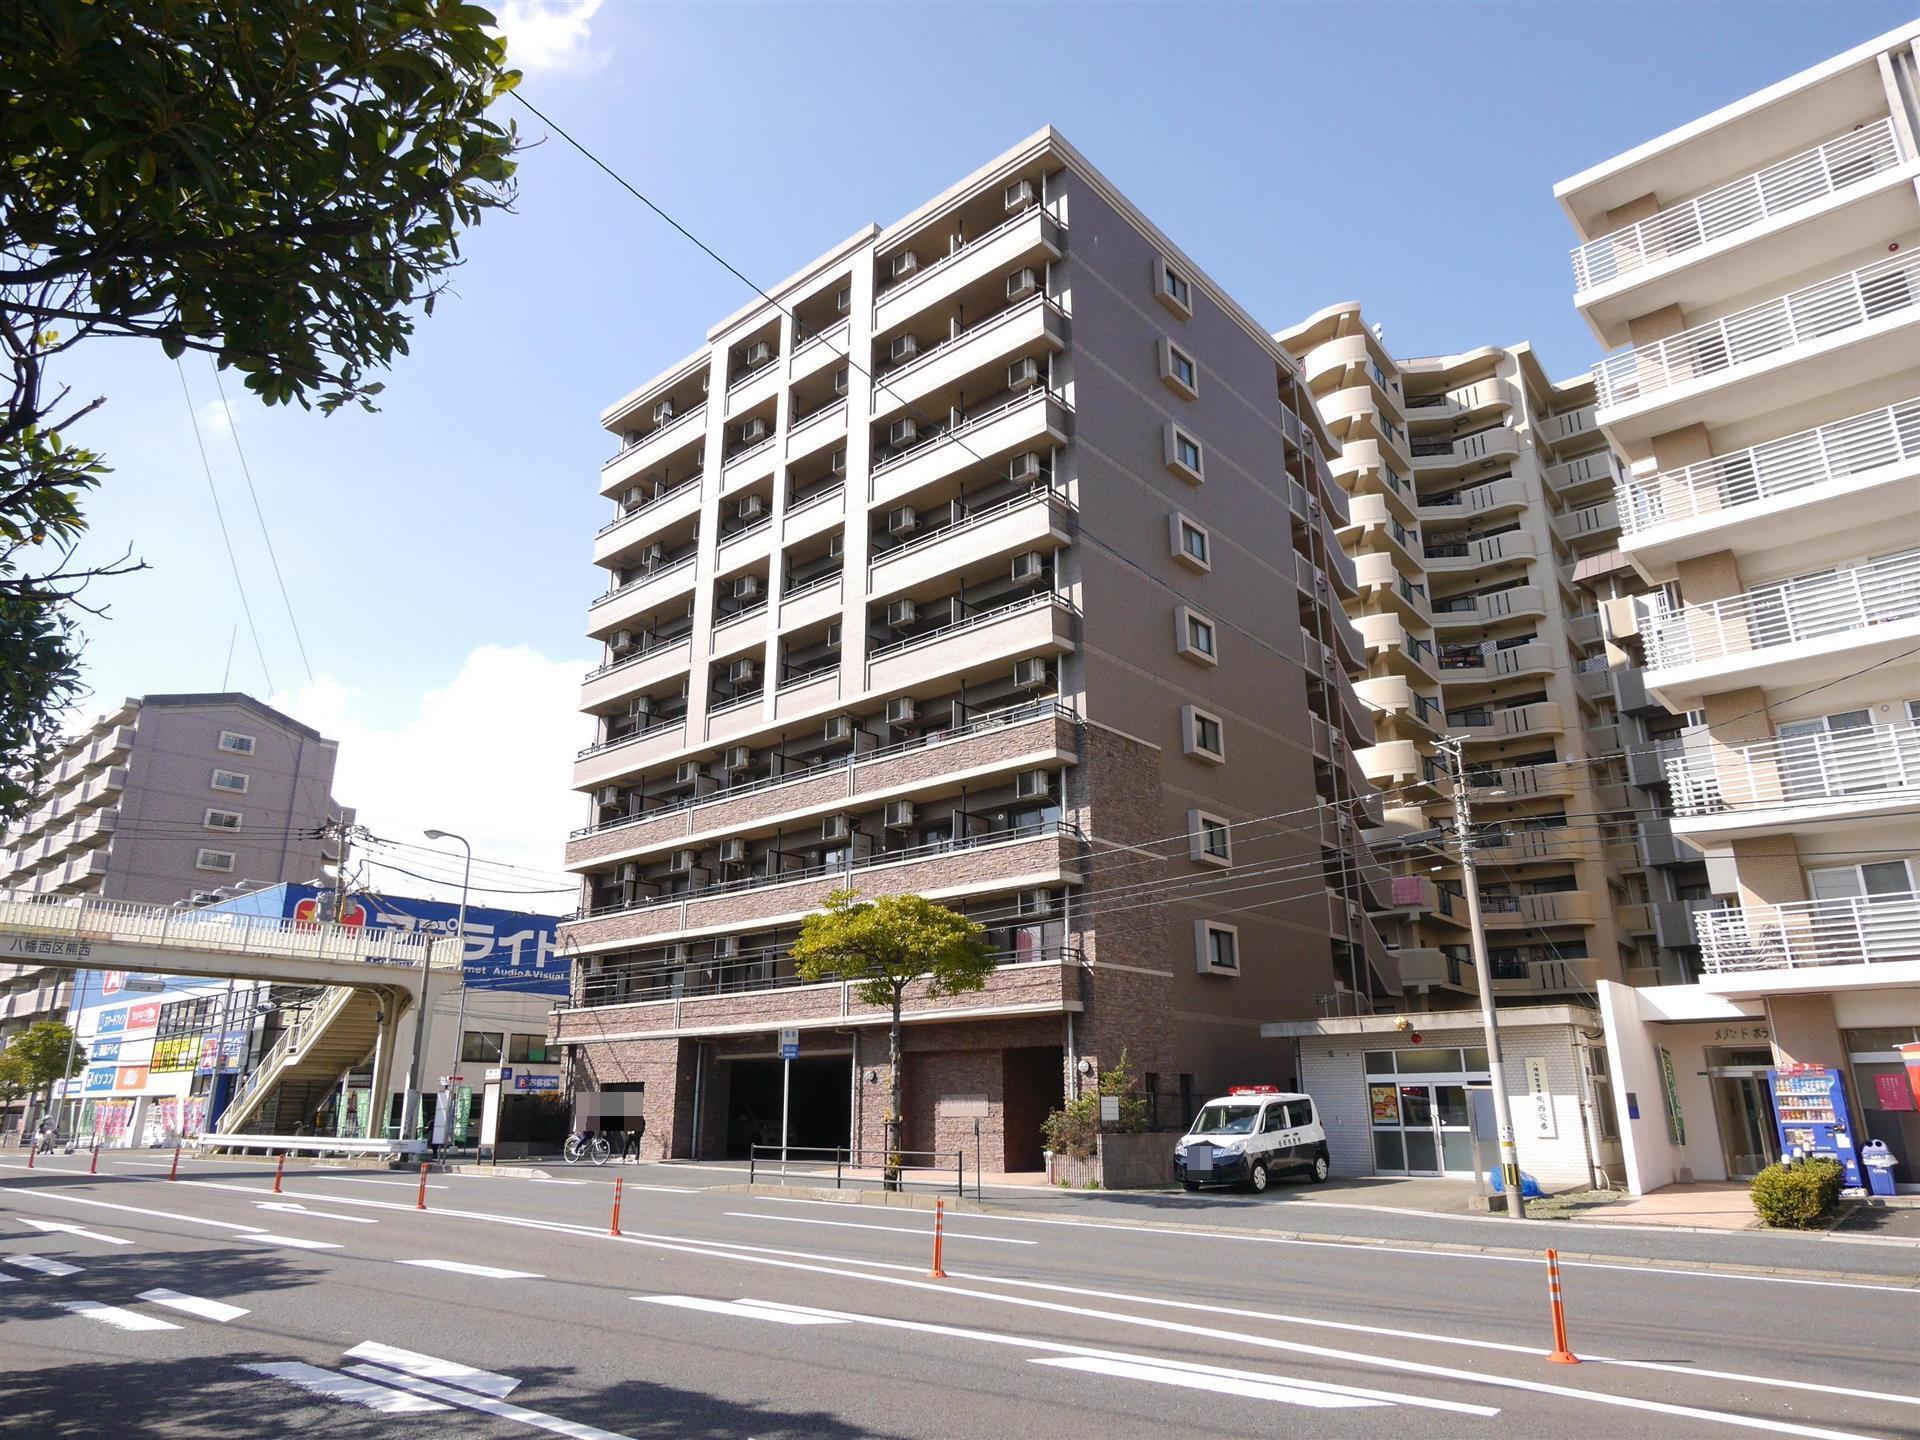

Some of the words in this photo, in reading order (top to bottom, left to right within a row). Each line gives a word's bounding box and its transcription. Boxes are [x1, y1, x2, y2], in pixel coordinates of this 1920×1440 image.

[10, 938, 92, 957] 八幡西区熊西
[493, 966, 565, 981] Audio&Visual
[94, 1072, 115, 1086] パソコン
